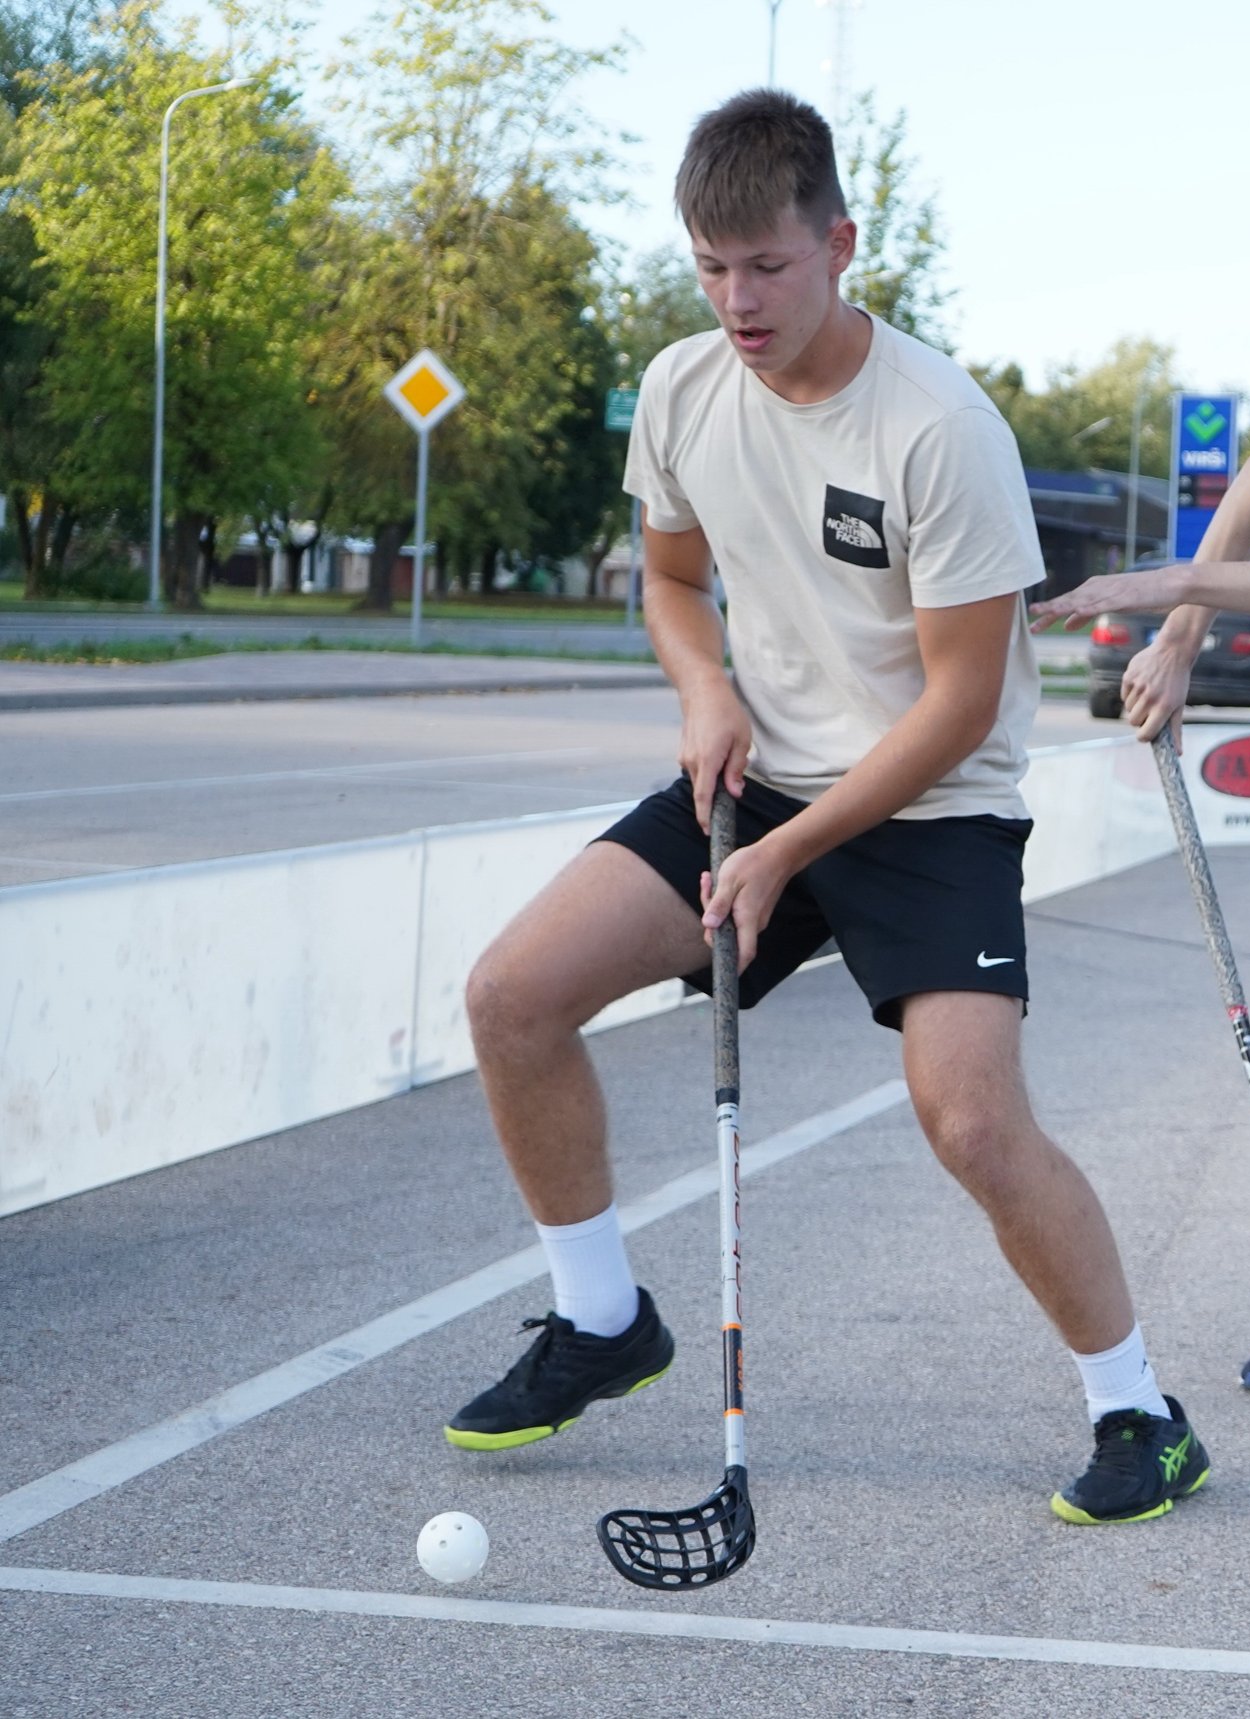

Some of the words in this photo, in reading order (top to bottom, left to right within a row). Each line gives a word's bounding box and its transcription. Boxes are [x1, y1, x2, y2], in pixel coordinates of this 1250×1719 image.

[826, 518, 858, 535] NORTH
[840, 512, 860, 527] THE
[835, 530, 861, 548] FACE
